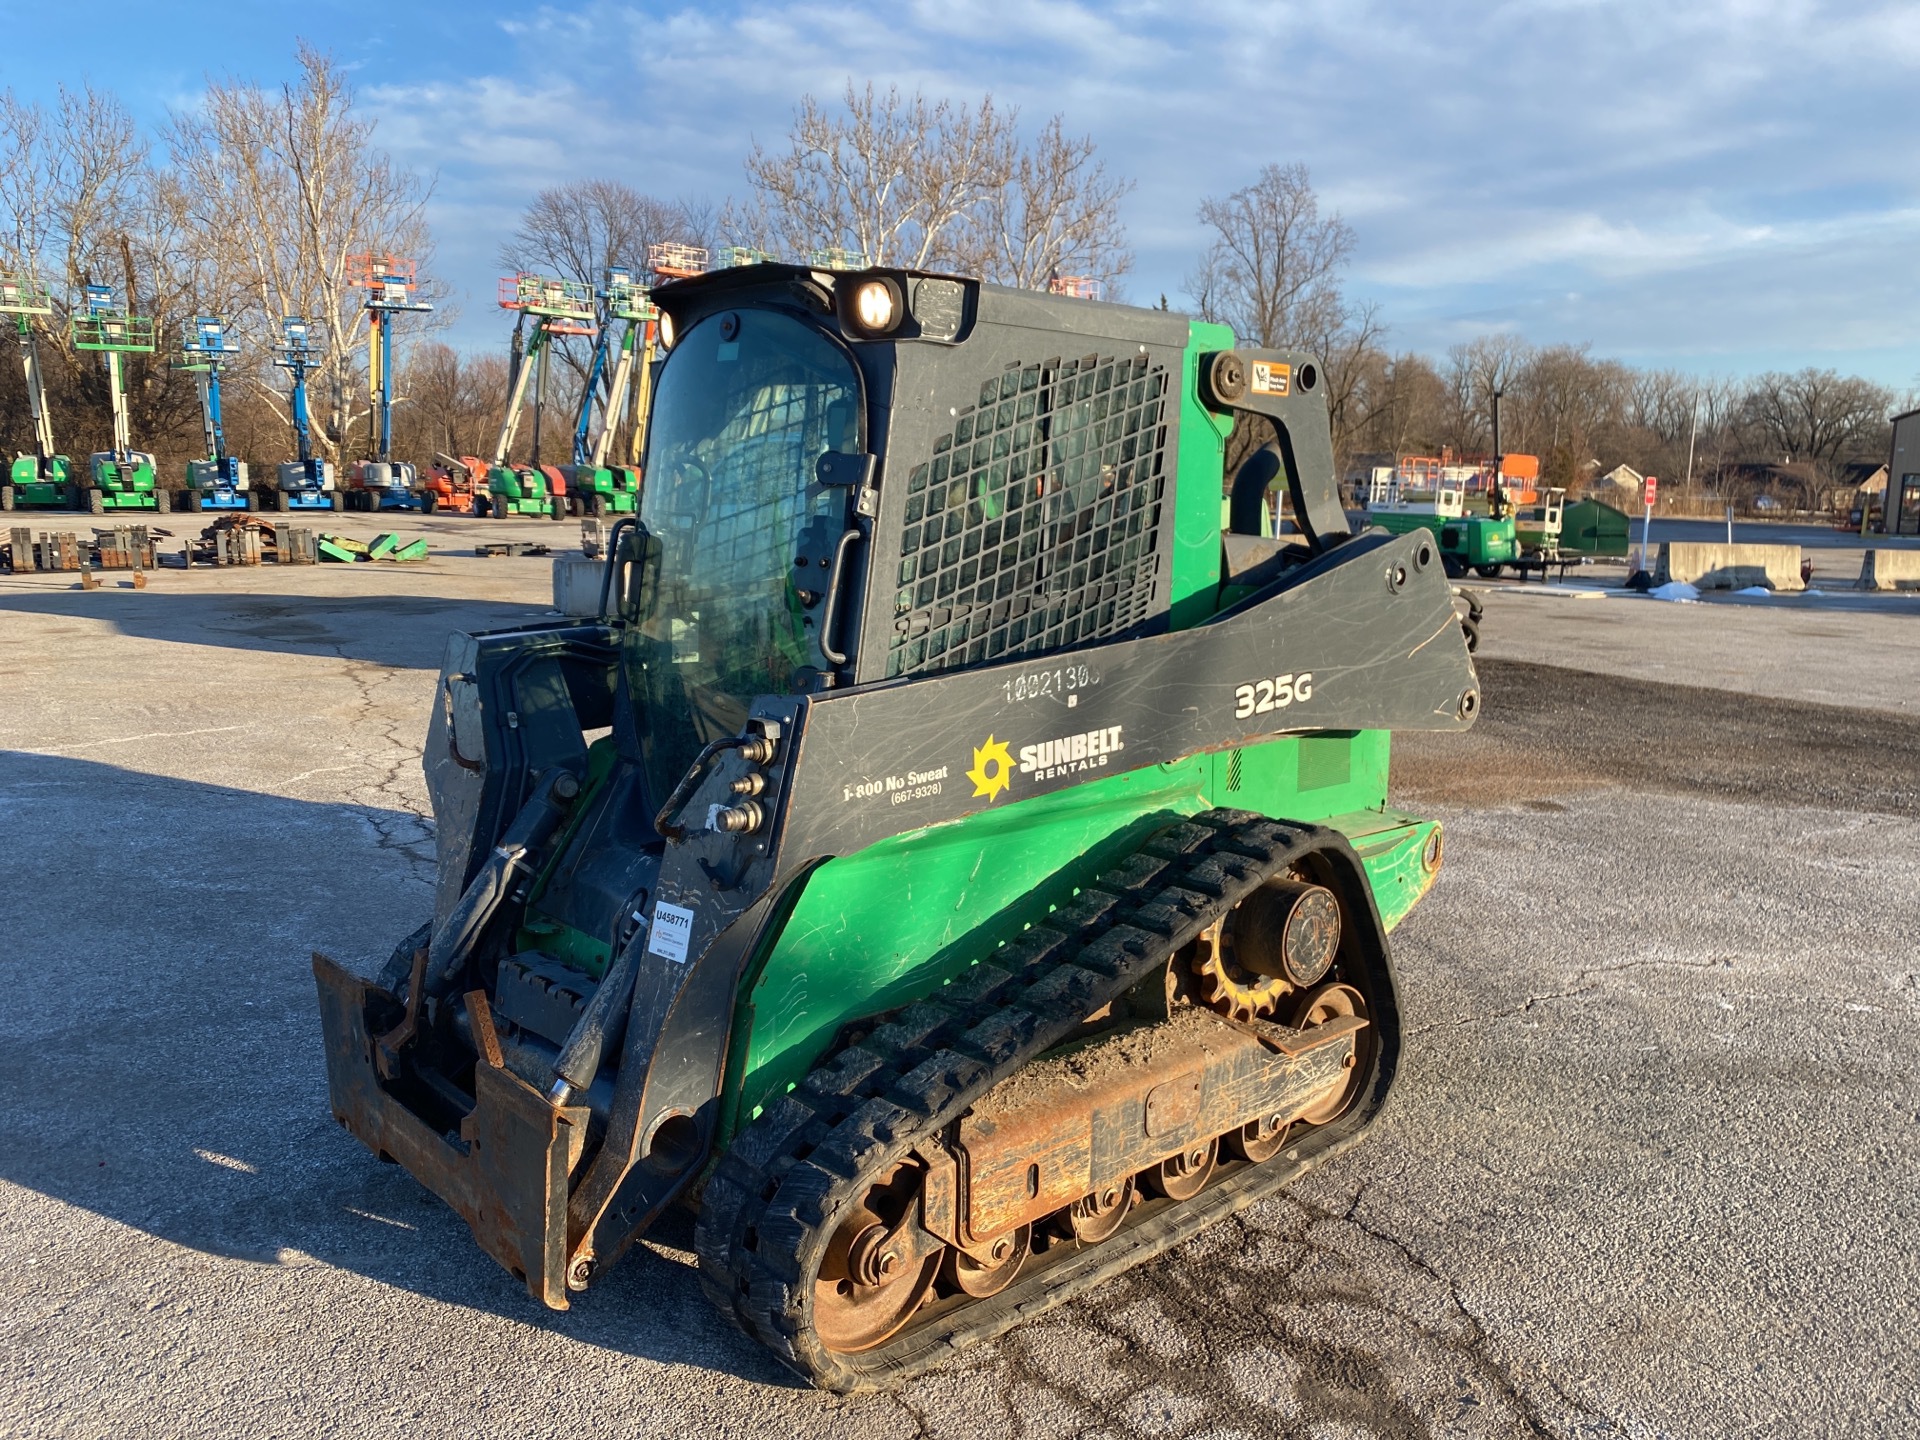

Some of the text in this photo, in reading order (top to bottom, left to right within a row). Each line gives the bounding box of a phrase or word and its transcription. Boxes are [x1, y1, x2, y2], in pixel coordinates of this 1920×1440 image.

[1235, 672, 1312, 720] 325G
[1020, 725, 1122, 773] SUNBELT
[886, 776, 905, 791] No
[907, 765, 948, 786] Sweat
[1035, 755, 1108, 782] RENTALS
[891, 782, 942, 806] (667-9328)
[656, 910, 689, 929] U458771
